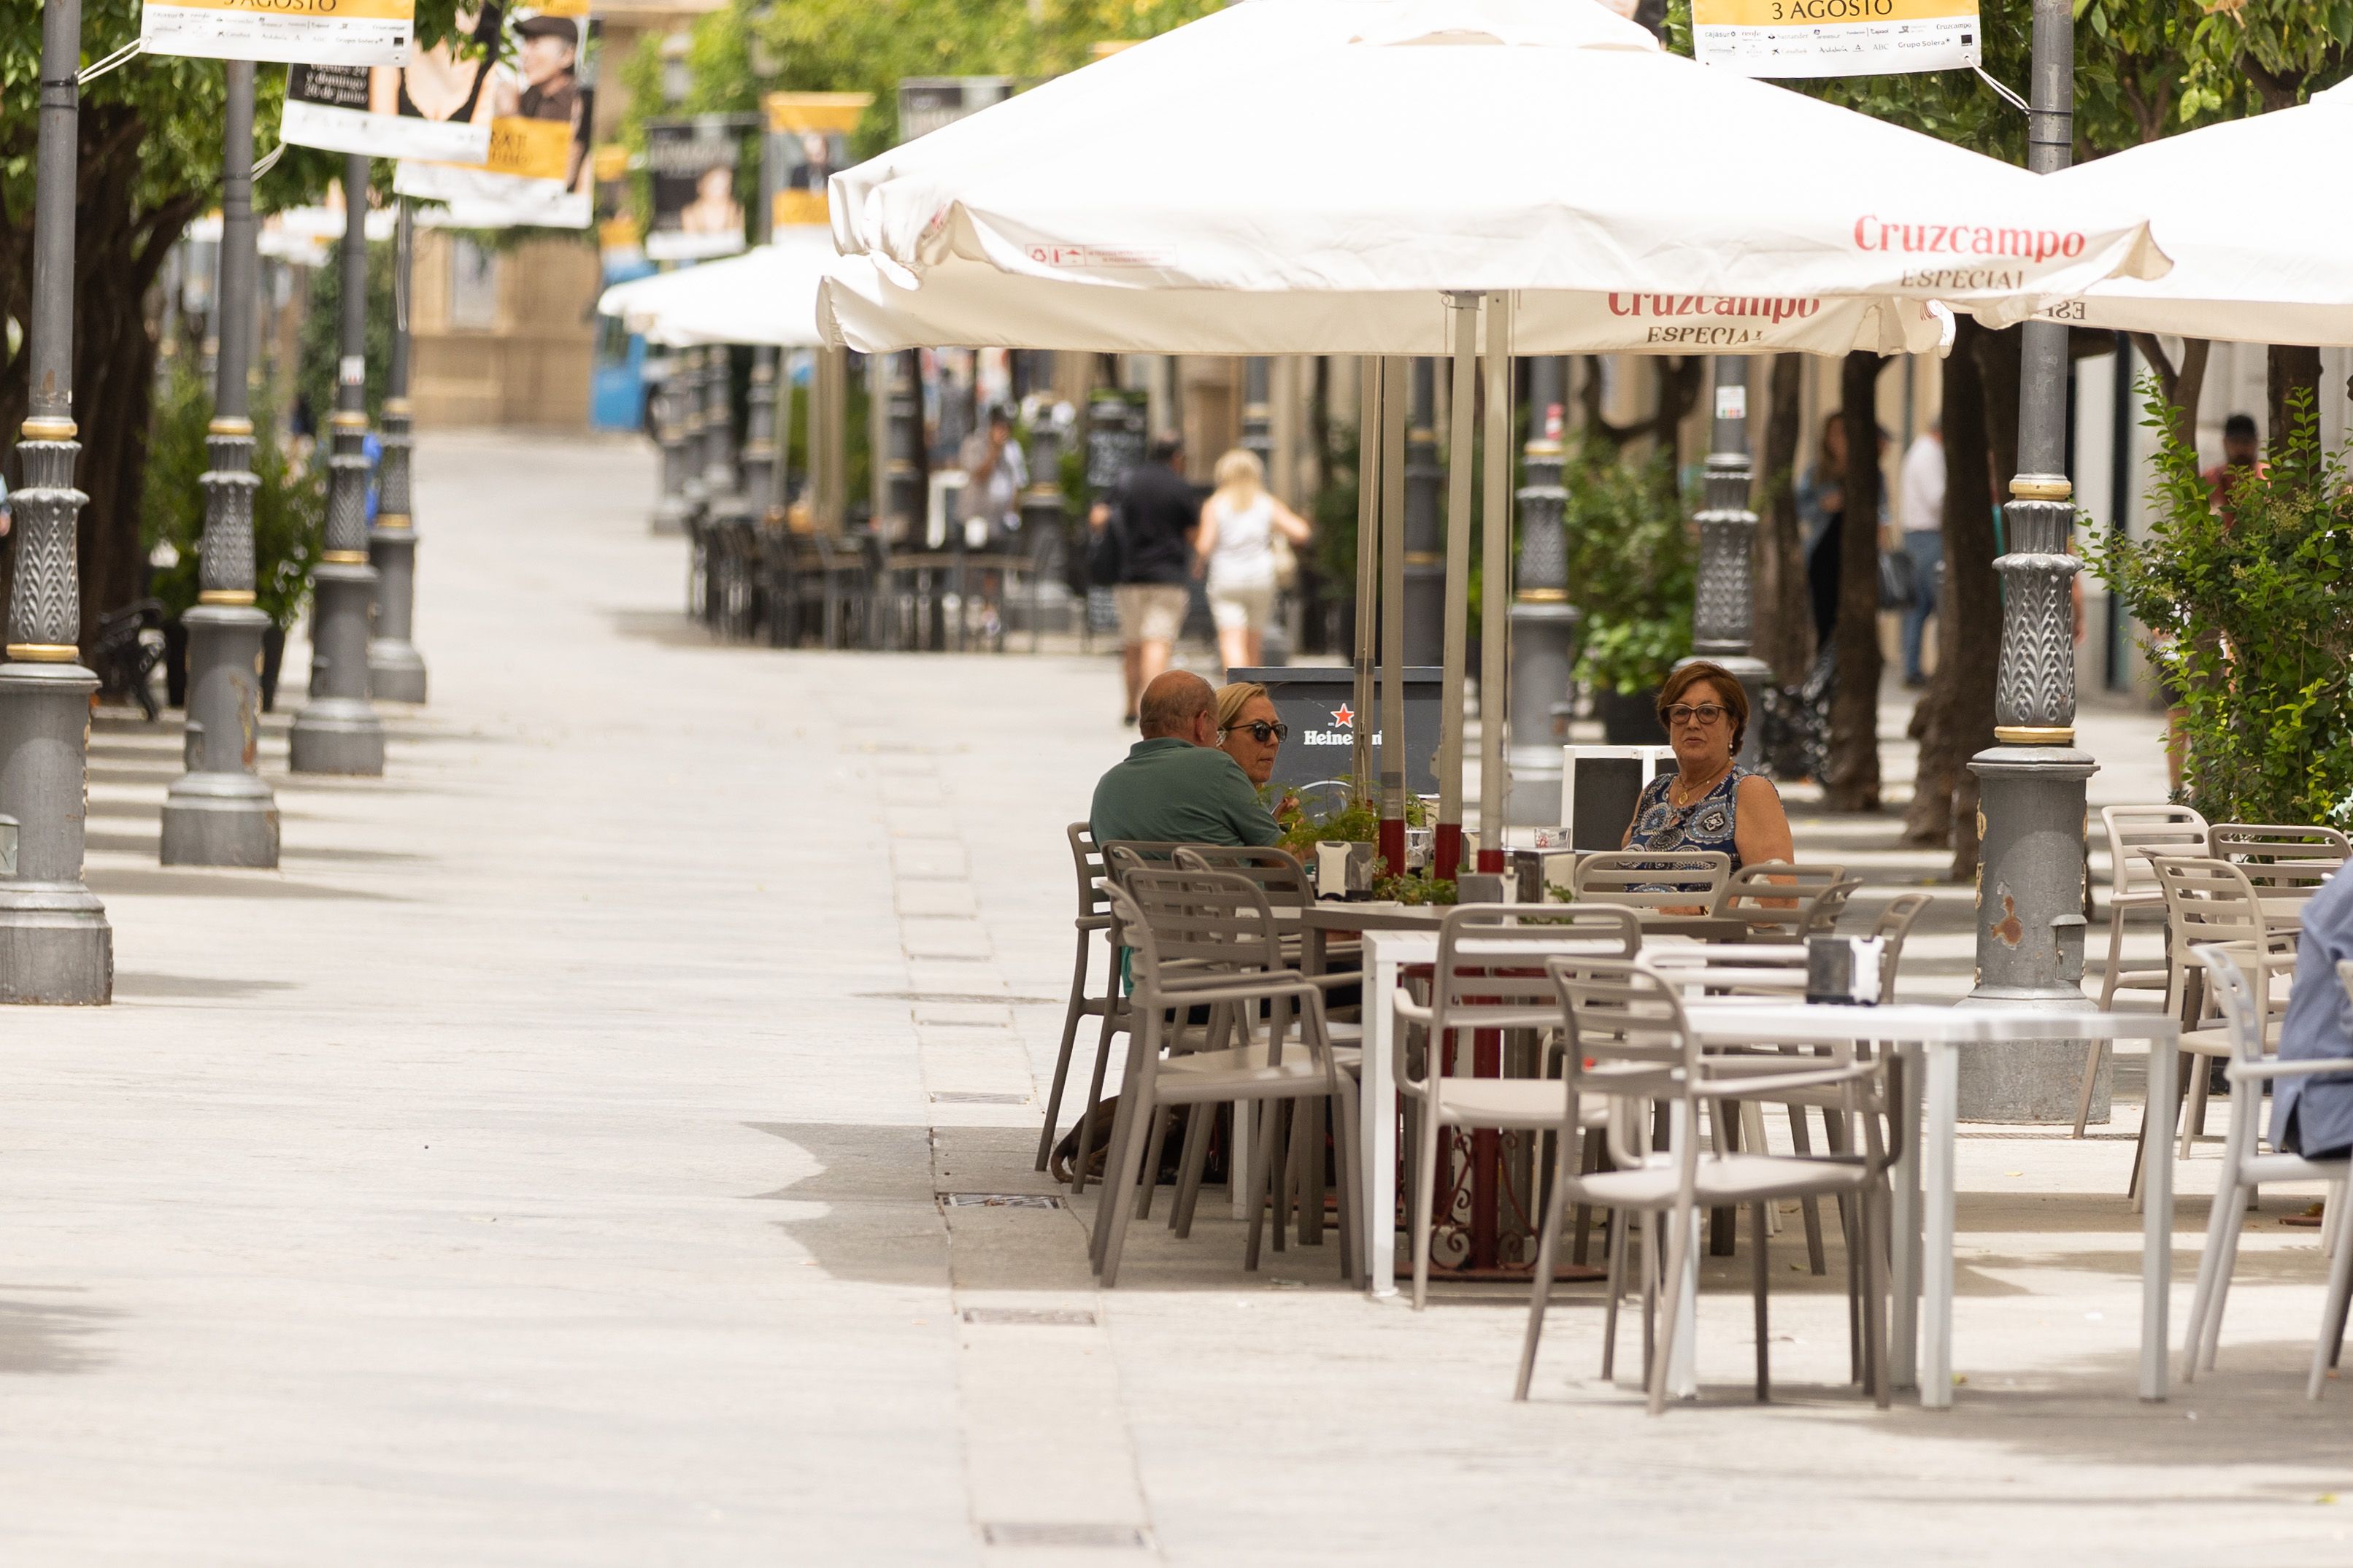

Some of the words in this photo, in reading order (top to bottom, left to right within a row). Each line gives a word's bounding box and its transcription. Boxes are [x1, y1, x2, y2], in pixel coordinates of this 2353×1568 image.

[1771, 2, 1783, 20] 3
[1790, 0, 1892, 19] AGOSTO
[1936, 23, 1972, 31] Cruzcampo
[1898, 41, 1921, 49] Grupo
[1922, 39, 1946, 47] Solera
[1854, 213, 2087, 263] Cruzcampo
